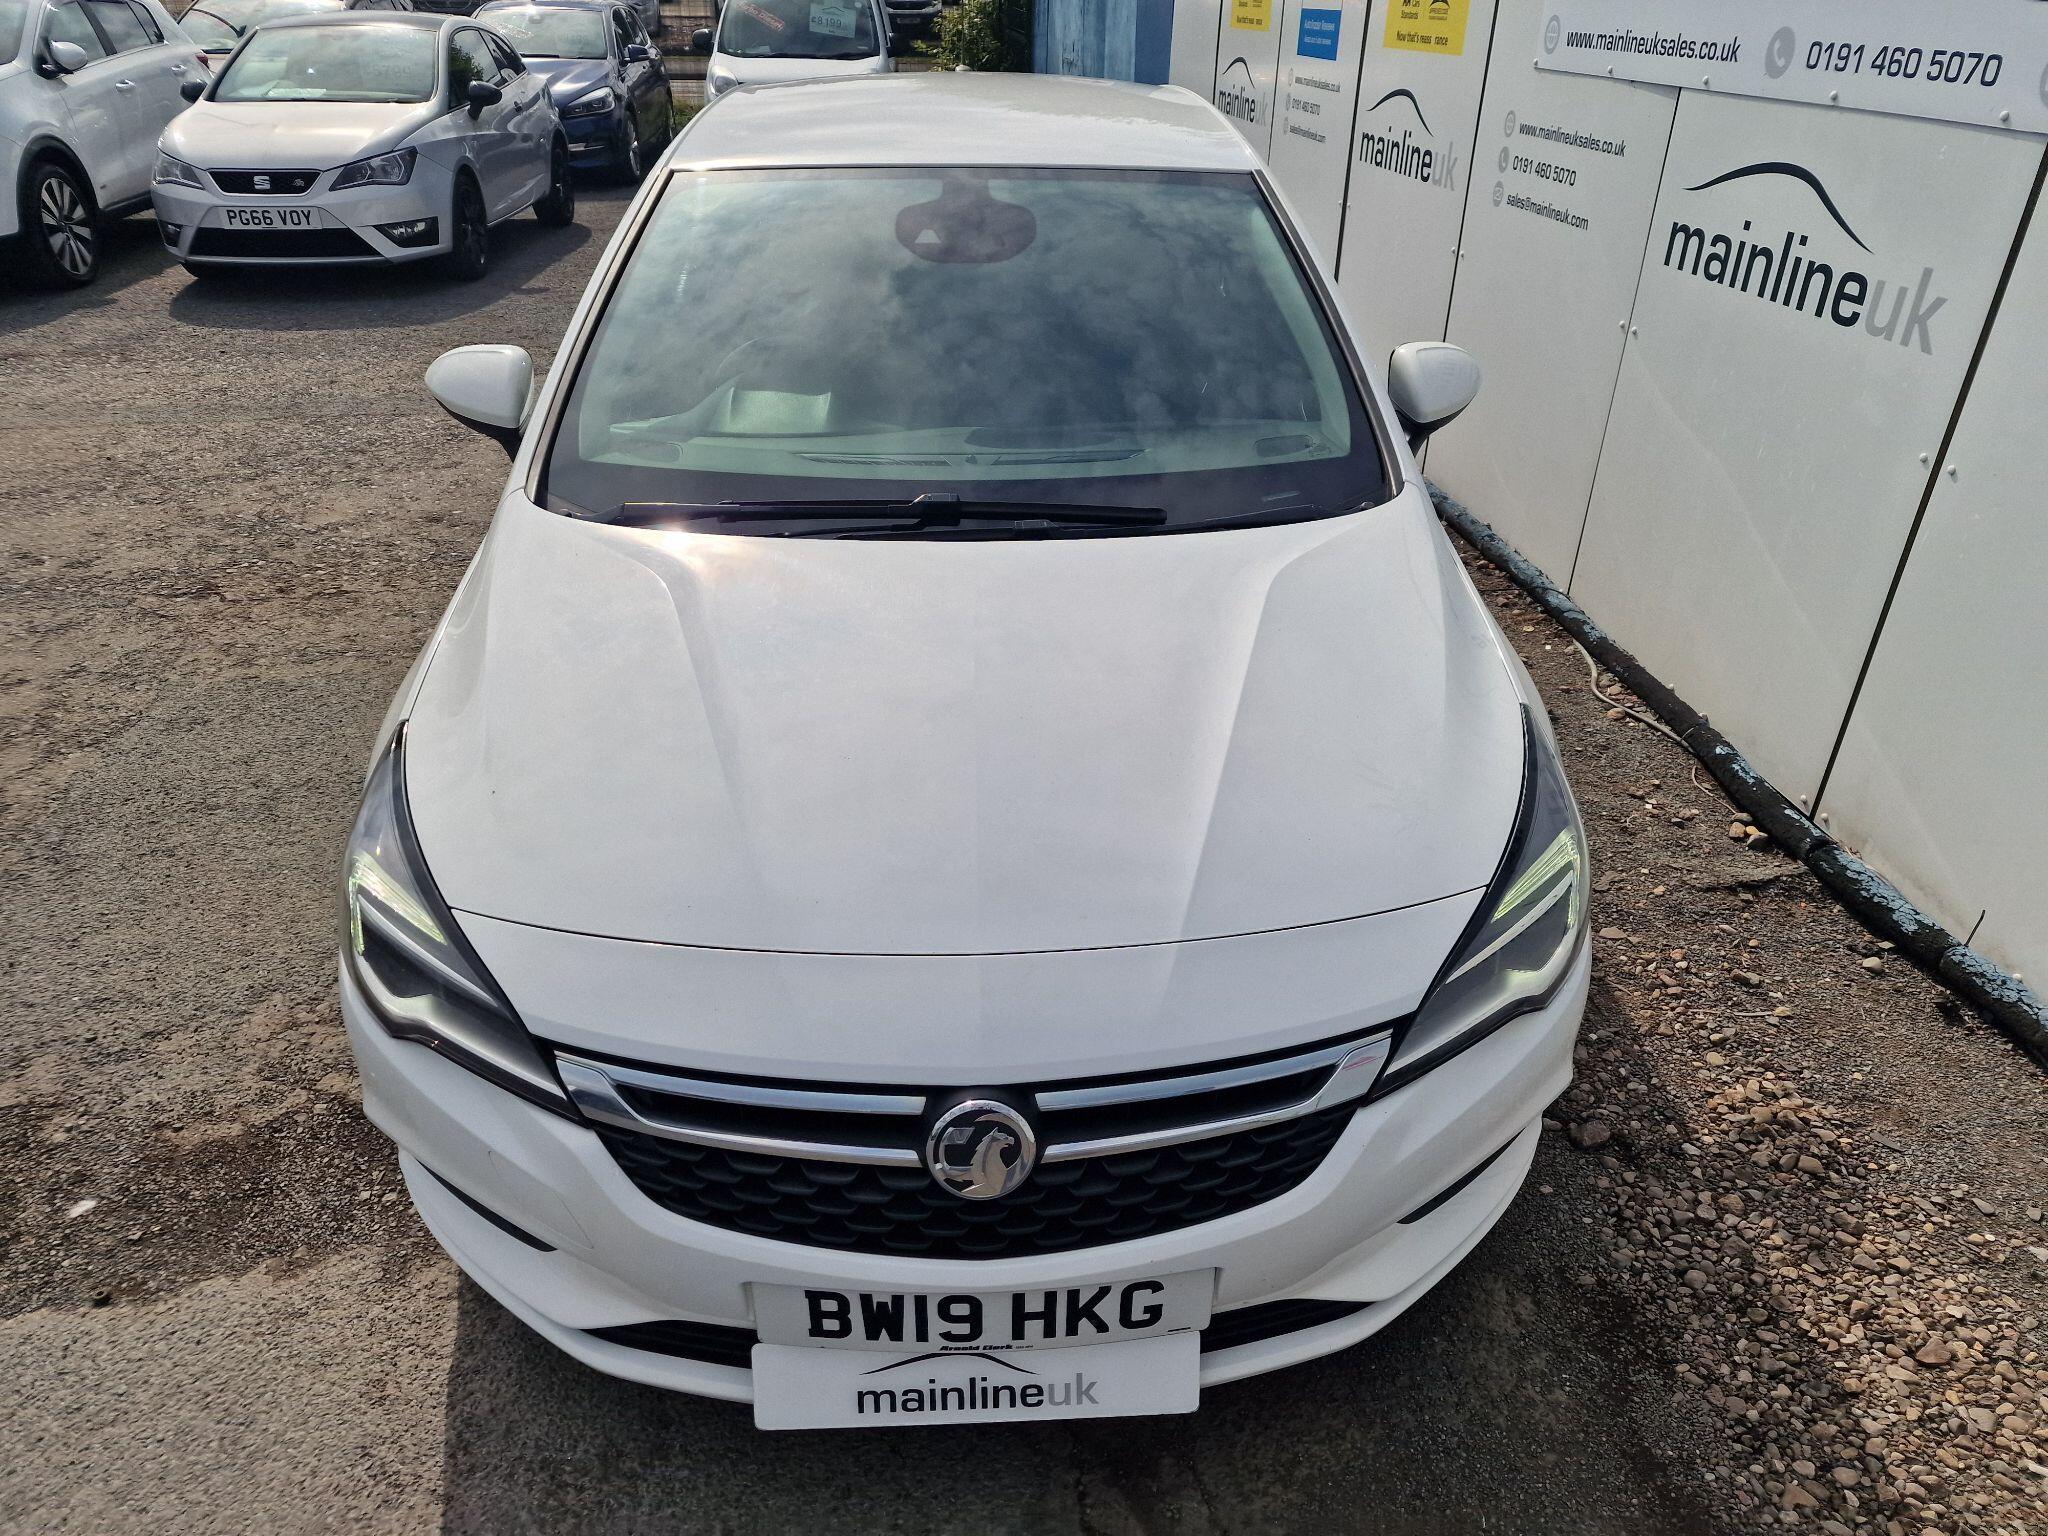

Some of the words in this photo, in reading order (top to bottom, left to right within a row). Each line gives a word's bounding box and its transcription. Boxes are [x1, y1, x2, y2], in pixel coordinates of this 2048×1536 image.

[1566, 29, 1741, 63] www.mainlineuksales.co.uk
[1806, 41, 1865, 74] 0191
[1871, 46, 1922, 79] 460
[1927, 50, 2003, 87] 5070
[1219, 85, 1267, 127] mainlineuk
[1359, 126, 1458, 191] mainlineuk
[1519, 121, 1627, 158] www.mainlineuksales.co.uk
[1512, 155, 1534, 173] 0191
[1535, 160, 1552, 180] 460
[1552, 165, 1577, 187] 5070
[226, 209, 274, 225] PG66
[277, 209, 311, 225] VOY
[1507, 191, 1589, 231] sales@mainlineuk.com
[1663, 220, 1948, 356] mainlineuk
[804, 1288, 984, 1343] BW19
[1010, 1280, 1165, 1342] HKG
[857, 1373, 1098, 1414] mainlineuk
